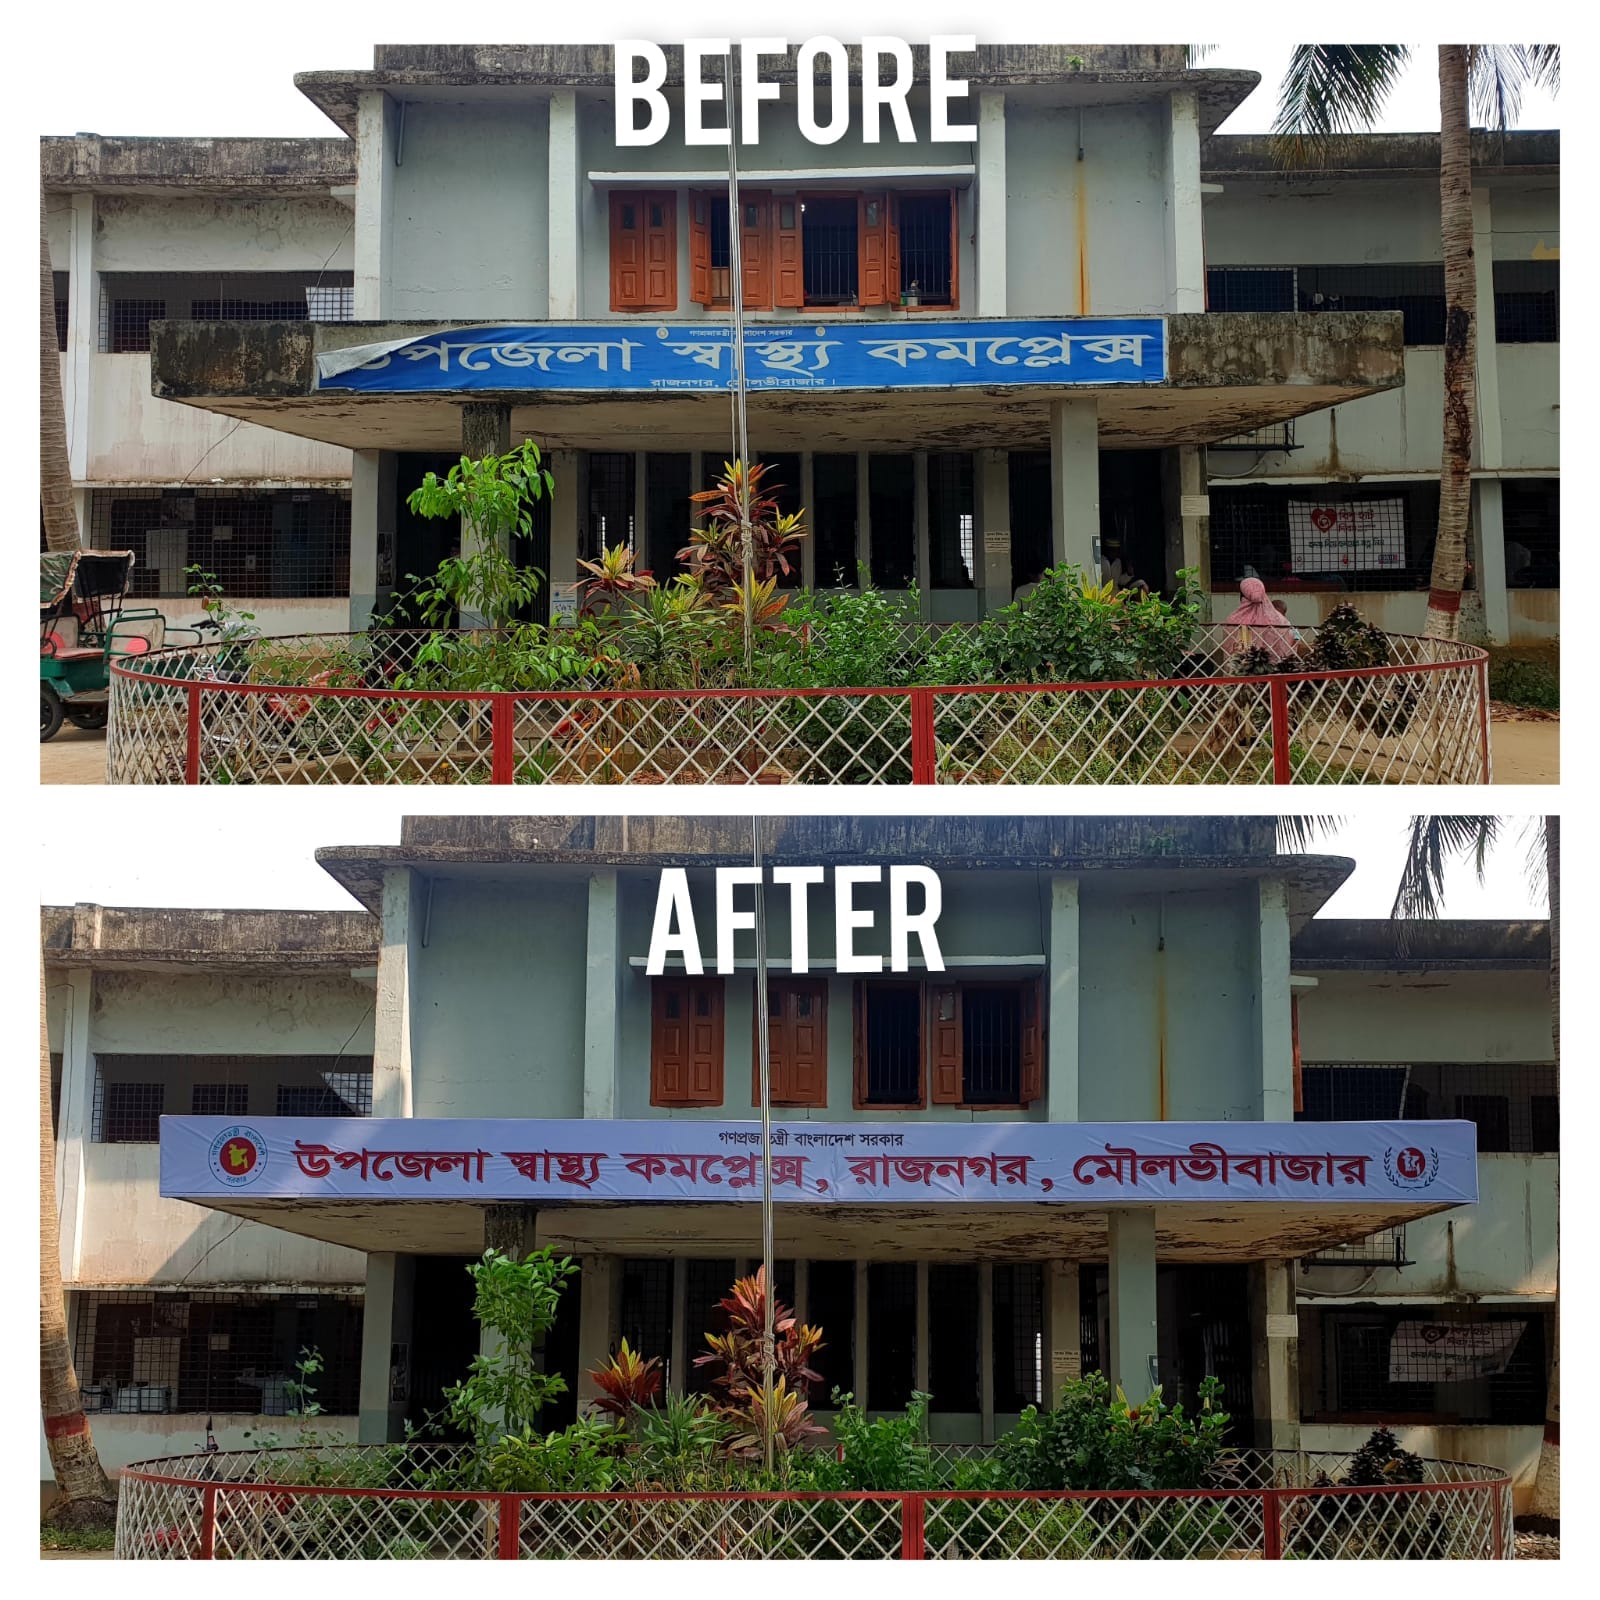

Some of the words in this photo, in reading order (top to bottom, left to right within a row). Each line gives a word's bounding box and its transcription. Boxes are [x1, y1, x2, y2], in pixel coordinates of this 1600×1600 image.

[858, 332, 1155, 369] কমপ্লেক্স
[718, 1130, 789, 1147] গণপ্রজান্ত্রী
[794, 1133, 855, 1147] বাংলাদেশ
[859, 1133, 904, 1147] সরকার
[290, 1139, 494, 1183] উপজেলা
[500, 1148, 609, 1190] স্বাস্থ্য
[620, 1151, 830, 1193] কমপ্লেক্স,
[844, 1152, 1055, 1193] রাজনগর,
[1073, 1142, 1375, 1187] মৌলভীবাজার
